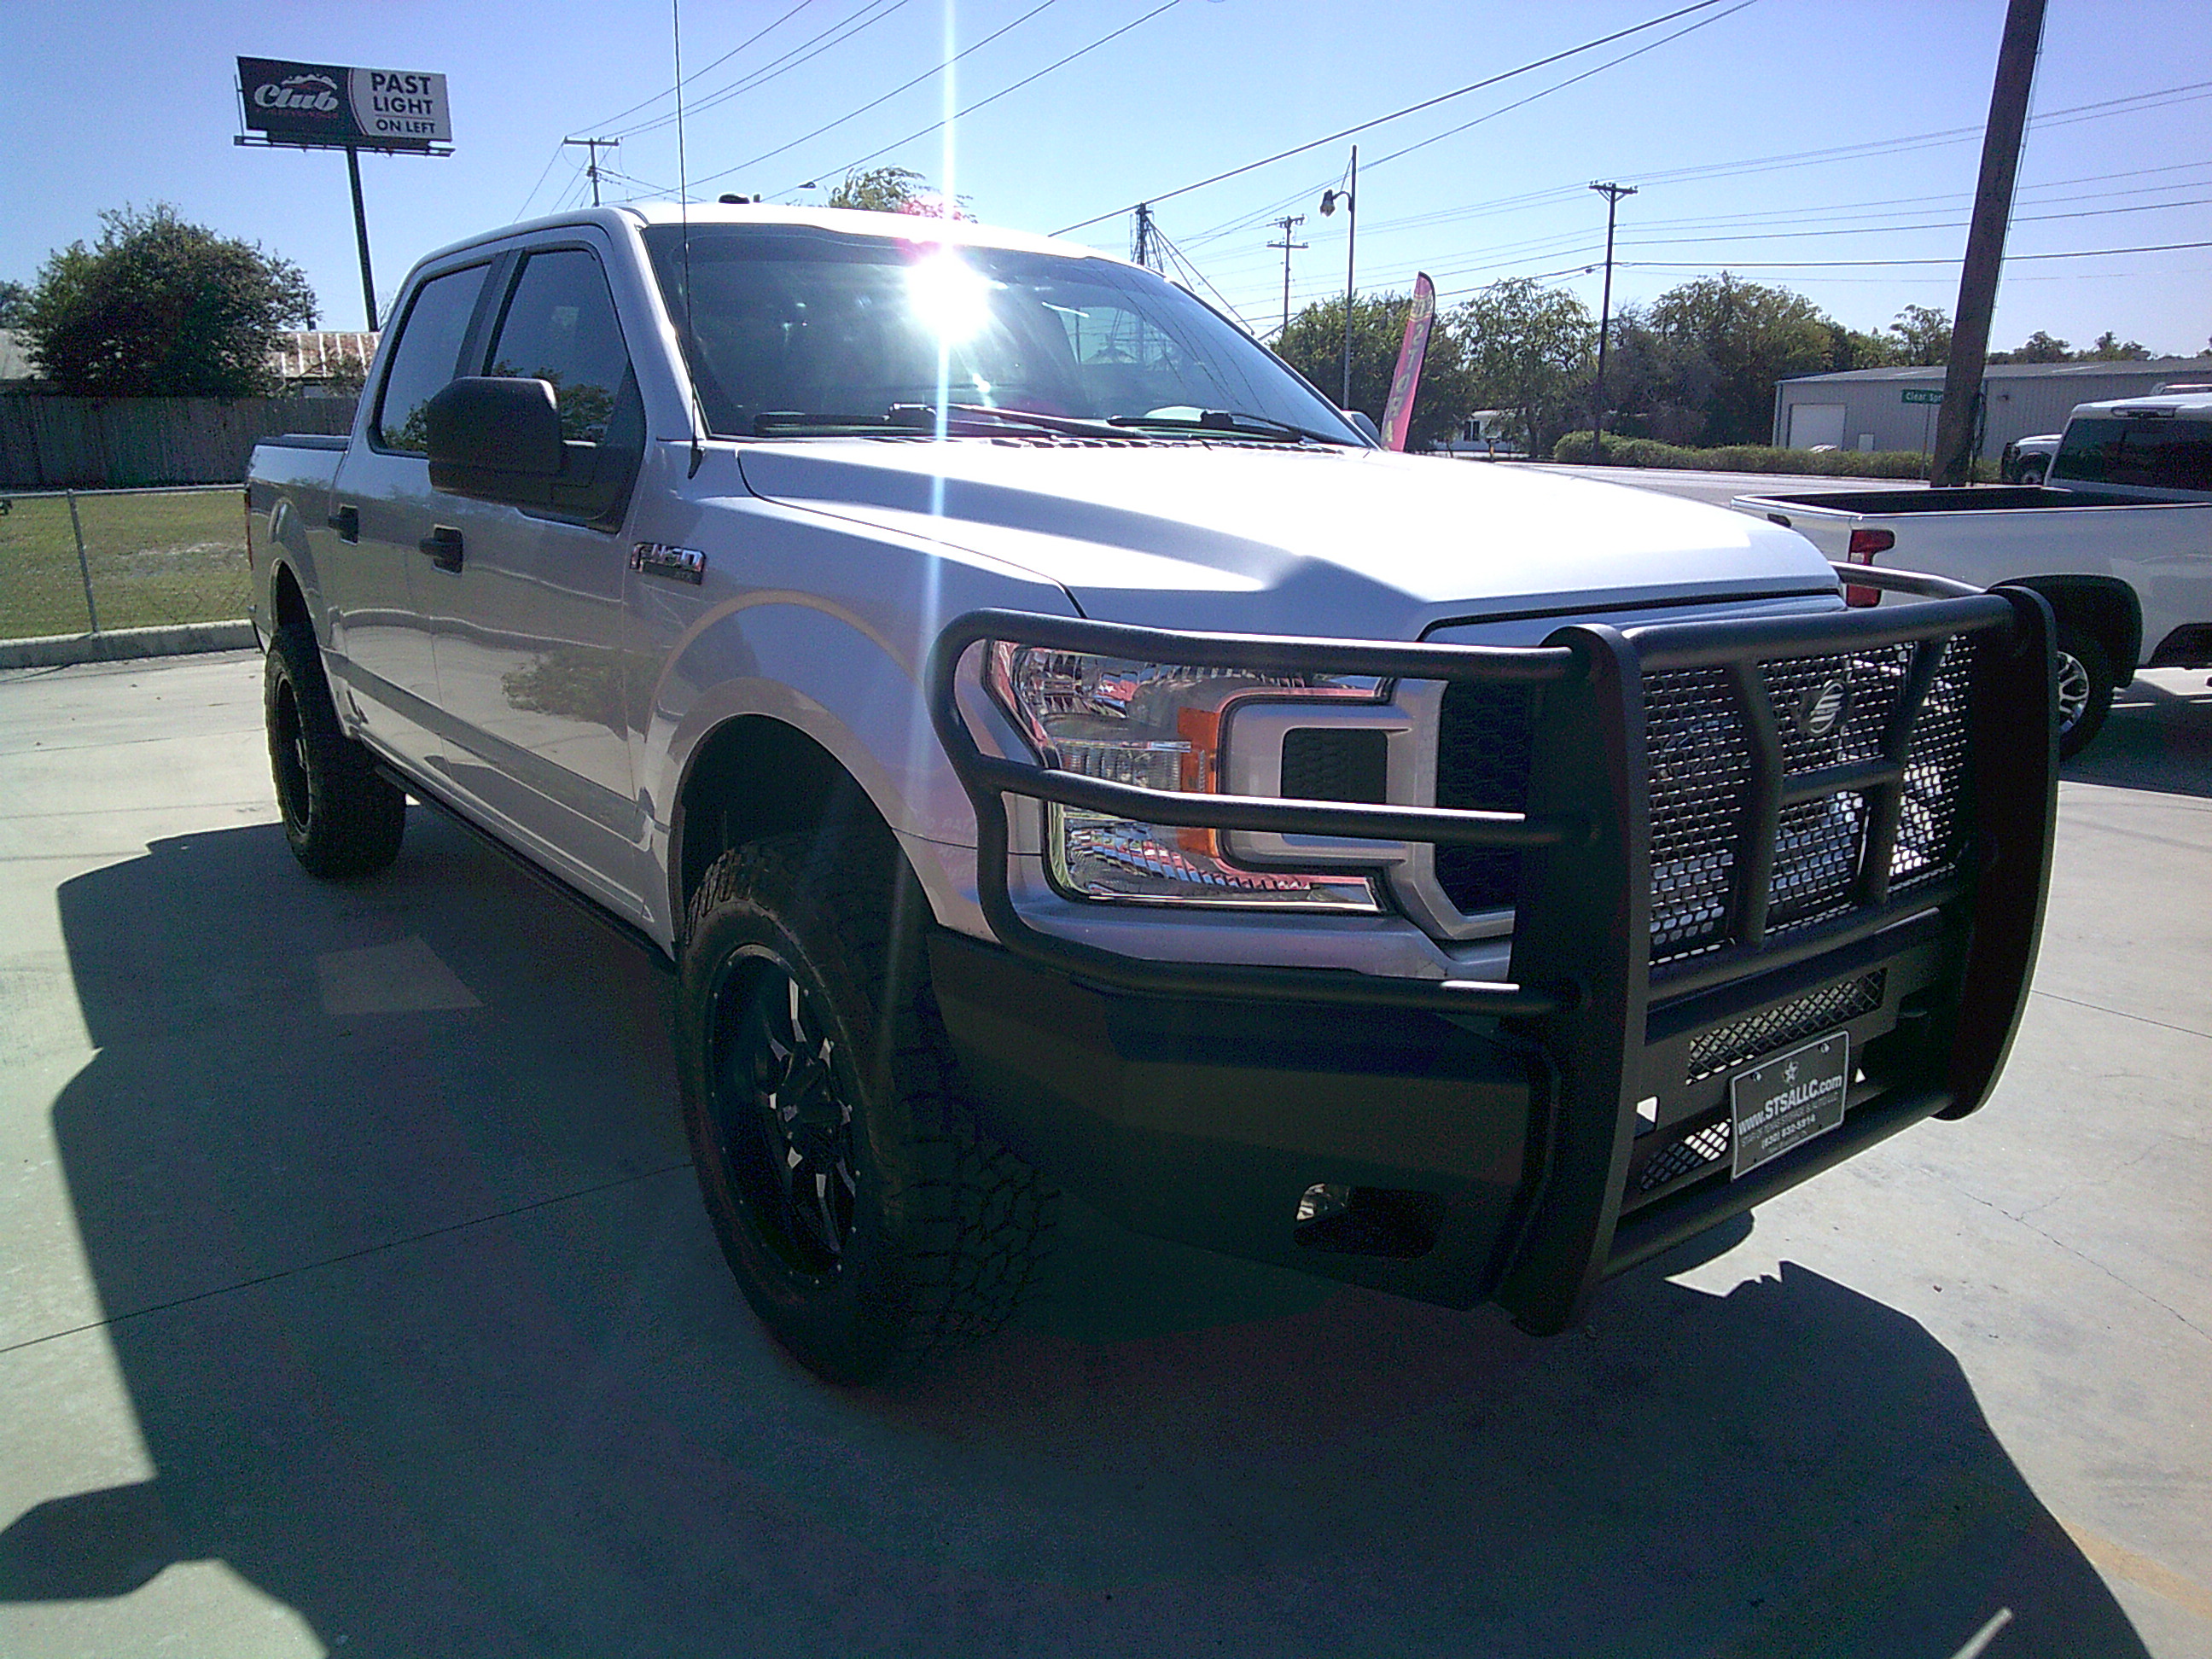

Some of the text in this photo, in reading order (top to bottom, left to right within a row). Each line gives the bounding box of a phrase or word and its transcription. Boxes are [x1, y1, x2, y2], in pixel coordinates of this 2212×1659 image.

[370, 72, 431, 96] PAST
[253, 84, 339, 111] Club
[373, 96, 434, 115] LIGHT
[375, 119, 436, 134] ON LEFT
[1906, 392, 1927, 402] Clear
[1738, 1074, 1842, 1136] www.STSALLC.com
